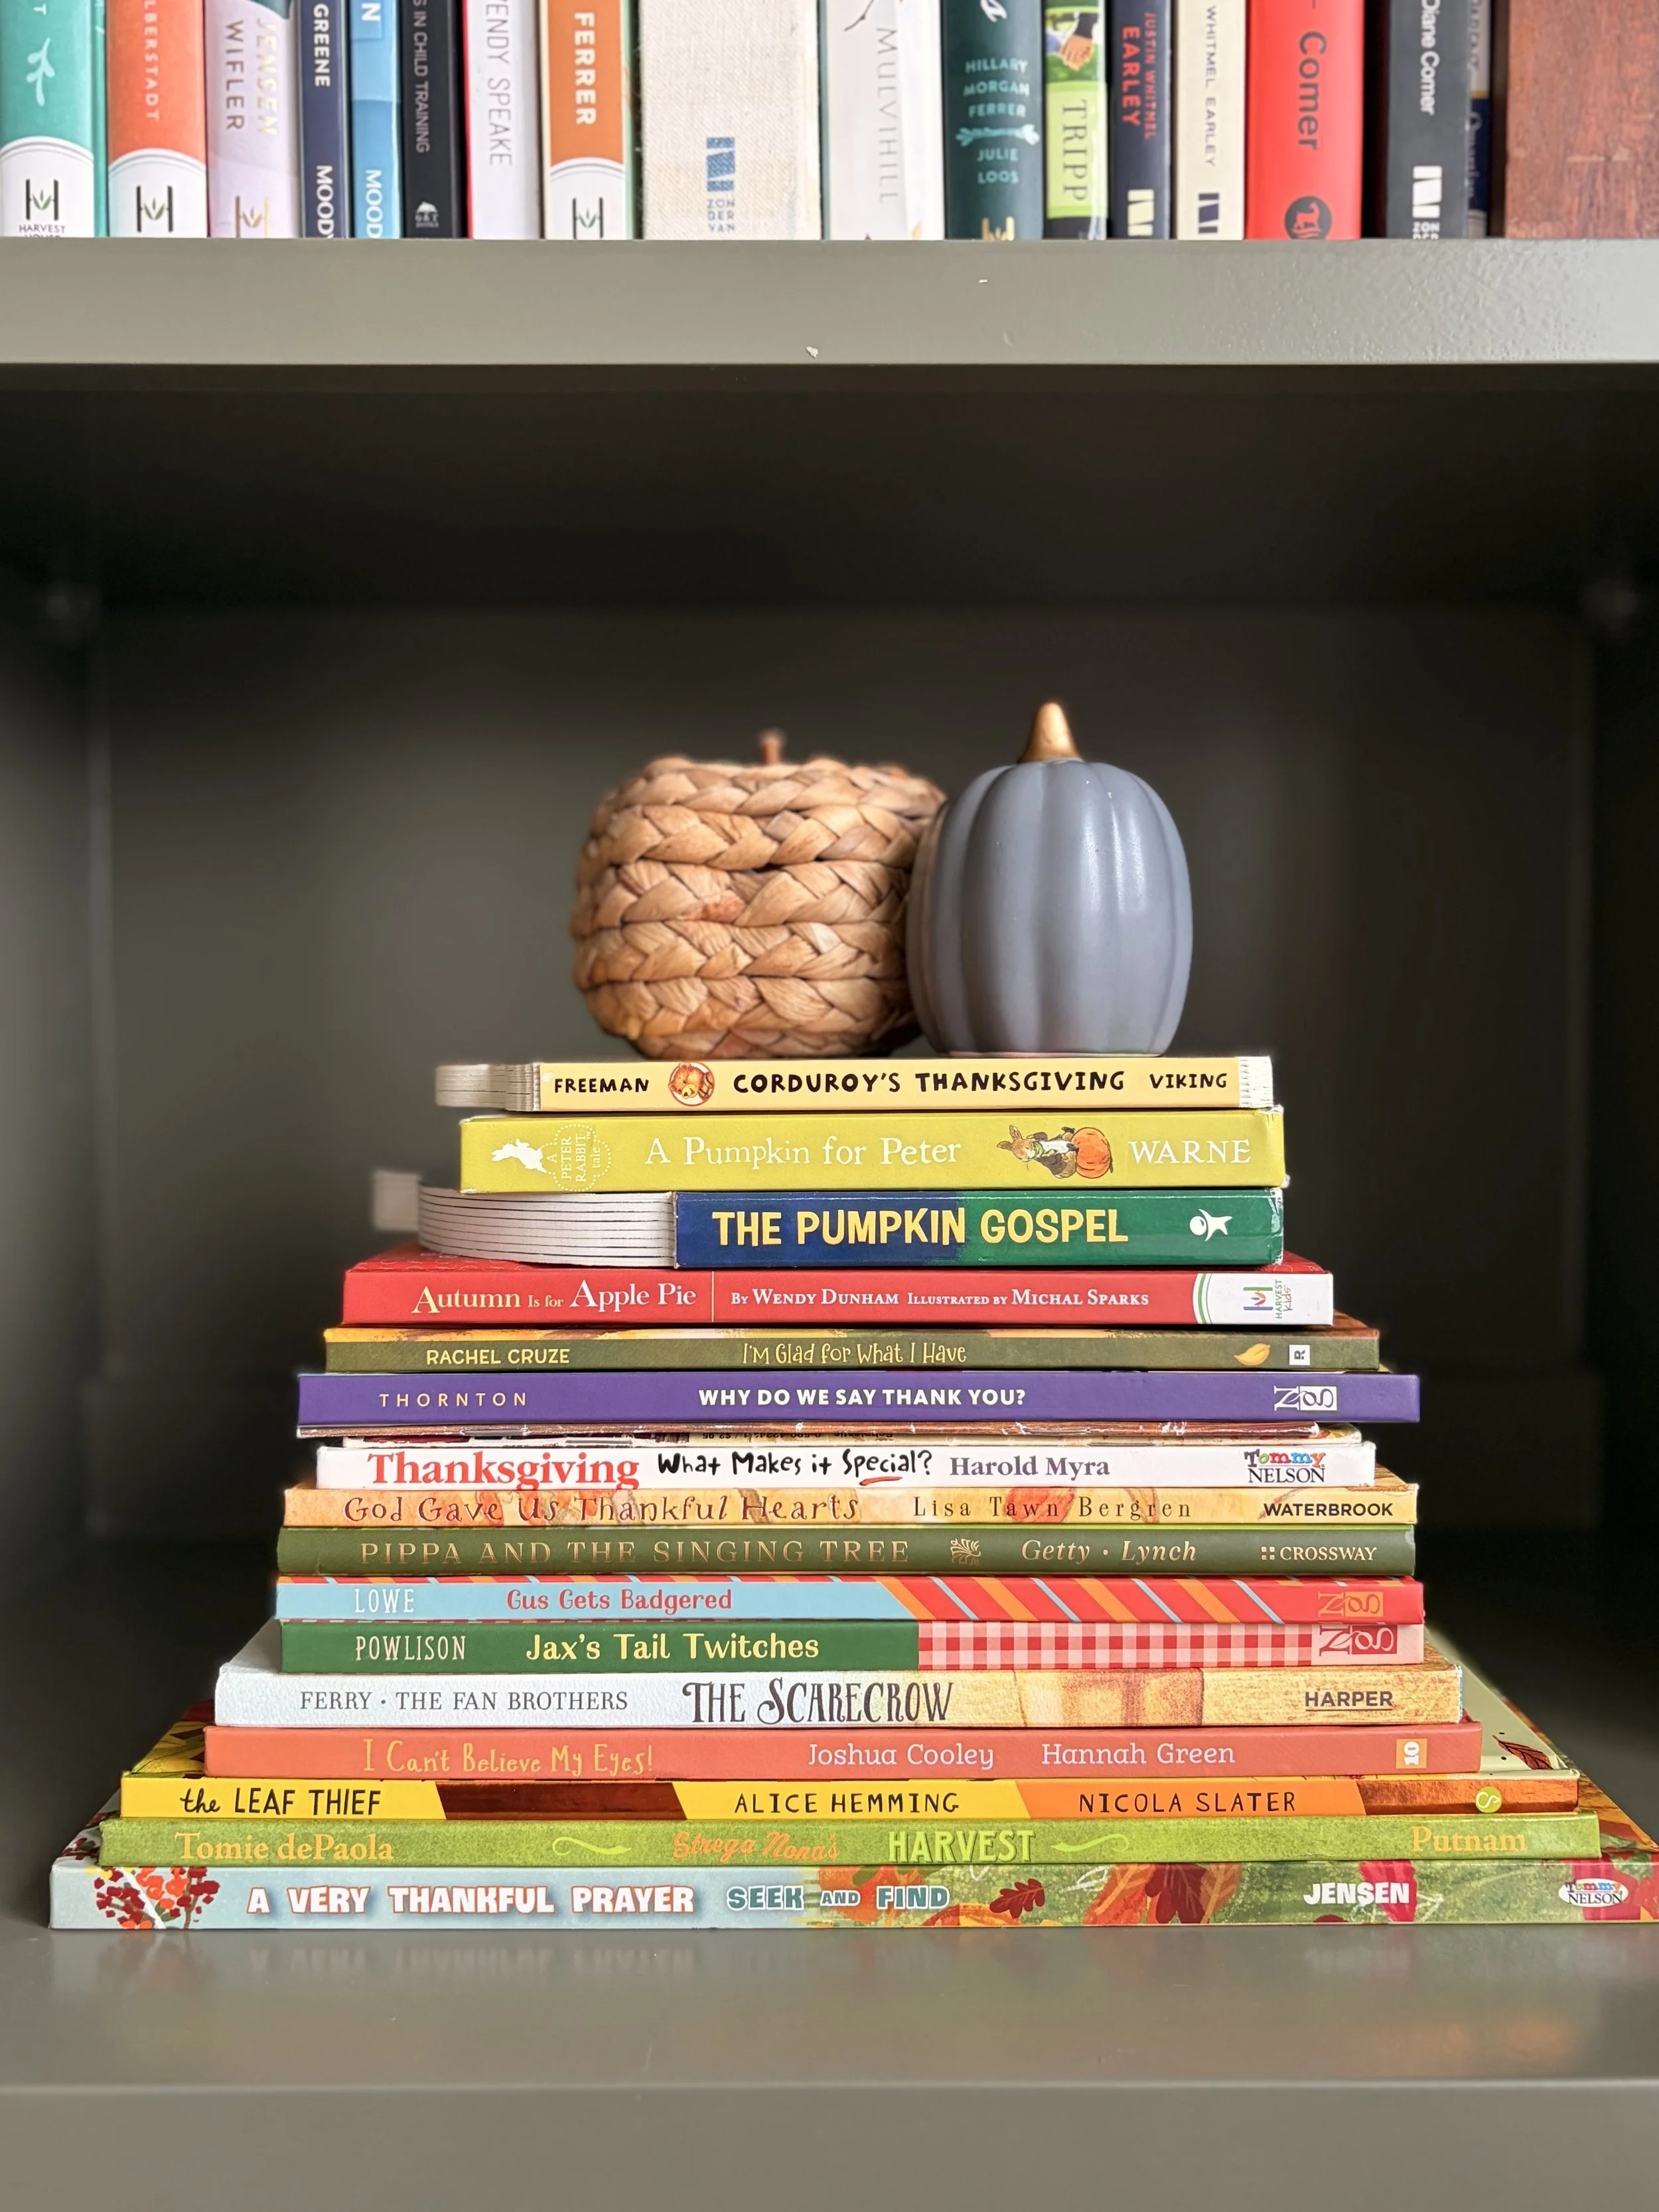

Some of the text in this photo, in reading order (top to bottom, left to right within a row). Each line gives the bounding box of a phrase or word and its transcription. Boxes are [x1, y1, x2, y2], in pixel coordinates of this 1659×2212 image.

[413, 11, 427, 27] IN
[313, 3, 331, 87] GREENE
[413, 32, 428, 77] CHILD
[226, 20, 245, 131] WIFLER
[255, 18, 279, 135] JENSEN
[574, 12, 597, 125] FERRER
[966, 60, 1027, 74] HILLARY
[1121, 26, 1141, 126] EARLEY
[1144, 12, 1157, 139] JUSTIN WHITMEL
[486, 0, 512, 166] ENDY SPEAKE
[964, 81, 1030, 96] MORGAN
[1205, 7, 1217, 167] WHITMEL EARLEY
[1297, 31, 1327, 151] Comer
[1420, 50, 1441, 115] Comer
[414, 81, 430, 153] TRAINING
[876, 27, 897, 204] MULVIHILL
[969, 104, 1026, 118] FERRER
[977, 148, 1018, 162] JULIE
[1063, 99, 1088, 201] TRIPP
[977, 171, 1018, 184] LOOS
[707, 200, 735, 208] ZON
[707, 212, 735, 221] DER
[19, 224, 66, 234] HARVEST
[707, 224, 735, 232] VAN
[1412, 222, 1440, 233] ZON
[554, 1078, 650, 1093] FREEMAN
[733, 1070, 1125, 1093] CORDUROY'S THANKSGIVING
[1149, 1073, 1227, 1089] VIKING
[547, 1153, 557, 1163] A
[561, 1137, 572, 1180] PETER
[590, 1147, 601, 1169] tale
[644, 1136, 962, 1169] A Pumpkin for Peter
[1128, 1139, 1251, 1164] WARNE
[711, 1207, 1128, 1246] THE PUMPKIN GOSPEL
[411, 1280, 696, 1314] Autumn Is for Apple Pie
[427, 1349, 570, 1364] RACHEL CRUZE
[775, 1343, 815, 1364] Glad
[857, 1343, 903, 1364] What
[910, 1343, 915, 1364] I
[922, 1342, 967, 1364] Have
[380, 1392, 526, 1407] THORNTON
[698, 1389, 1026, 1406] WHY DO WE SAY THANK YOU?
[367, 1451, 640, 1490] Thanksgiving
[658, 1449, 932, 1477] What Makes it Special?
[950, 1455, 1110, 1481] Harold Myra
[1244, 1449, 1326, 1467] Tommy
[1248, 1468, 1325, 1483] NELSON
[344, 1495, 859, 1522] God Gave Us Thankful Hearts
[913, 1496, 1191, 1521] Lisa Tawn Bergren
[1263, 1503, 1393, 1517] WATERBROOK
[360, 1540, 909, 1564] PIPPA AND THE SINGING TREE
[1021, 1540, 1196, 1566] Getty Lynch
[1279, 1546, 1377, 1562] CROSSWAY
[355, 1588, 414, 1613] LOWE
[506, 1589, 732, 1615] Gus Gets Badgered
[356, 1635, 466, 1660] POWLISON
[526, 1633, 820, 1660] Jax's Tail Twitches
[300, 1691, 628, 1710] FERRY THE FAN BROTHERS
[682, 1676, 953, 1724] THE SCARECROW
[1305, 1691, 1393, 1707] HARPER
[363, 1739, 653, 1777] I Can't Believe My Eyes!
[808, 1742, 1236, 1770] Joshua Cooley Hannah Green
[1404, 1741, 1419, 1765] 10
[180, 1788, 381, 1815] the LEAF THIEF
[734, 1793, 959, 1813] ALICE HEMMING
[1079, 1792, 1295, 1813] NICOLA SLATER
[174, 1832, 393, 1861] Tomie dePaola
[672, 1831, 755, 1864] Strega
[888, 1830, 1035, 1862] HARVEST
[1411, 1826, 1528, 1853] Putnam
[246, 1885, 950, 1915] A VERY THANKFUL PRAYER SEEK AND FIND
[1303, 1882, 1409, 1905] JENSEN
[1568, 1891, 1623, 1904] NELSON
